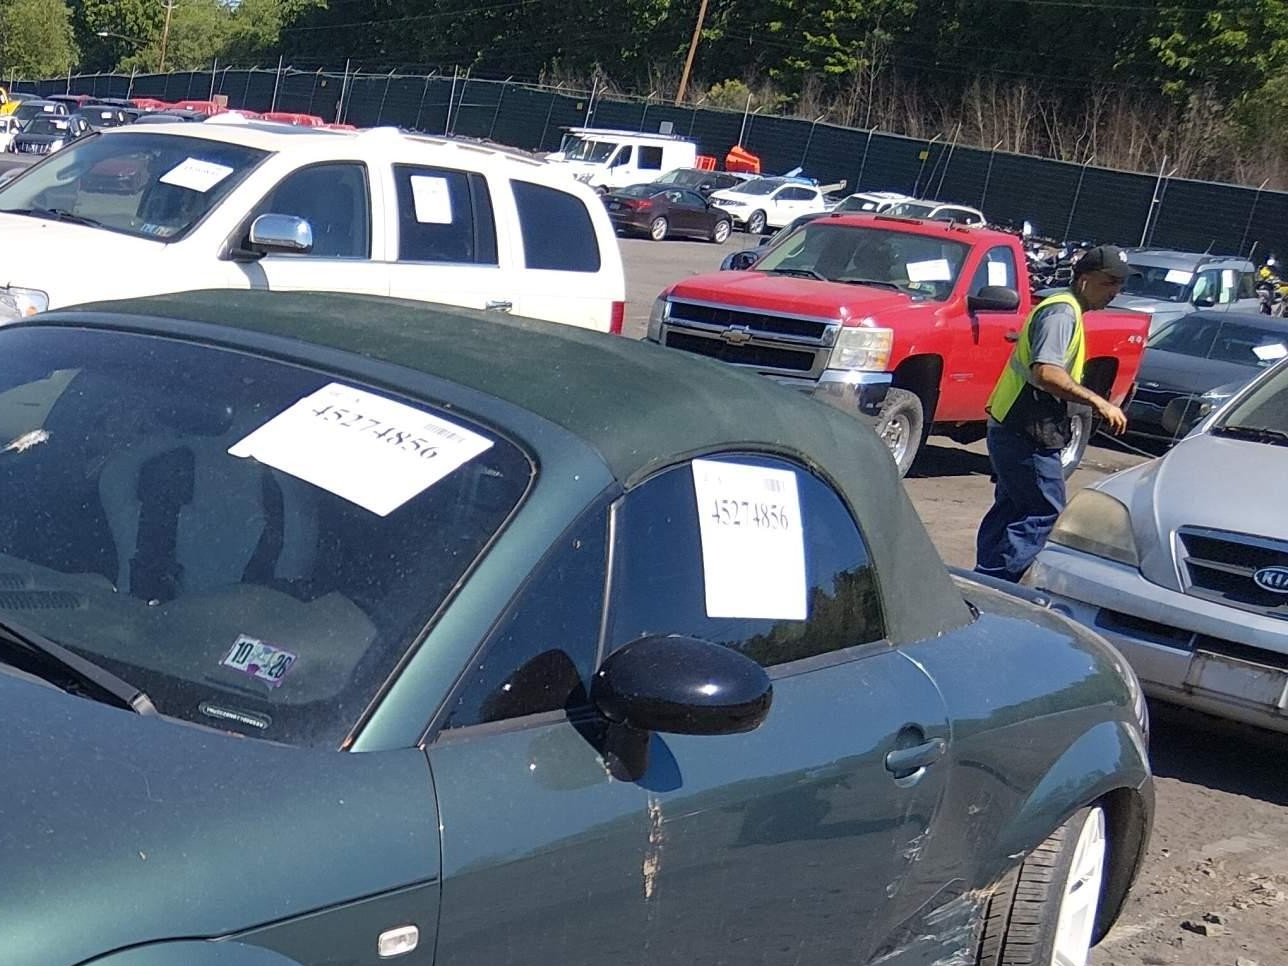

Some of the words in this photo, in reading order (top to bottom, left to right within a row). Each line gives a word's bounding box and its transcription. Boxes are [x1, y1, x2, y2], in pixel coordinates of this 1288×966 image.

[311, 404, 439, 460] 45274856
[711, 498, 790, 530] 45274856
[232, 641, 254, 664] 10
[267, 654, 292, 678] 26
